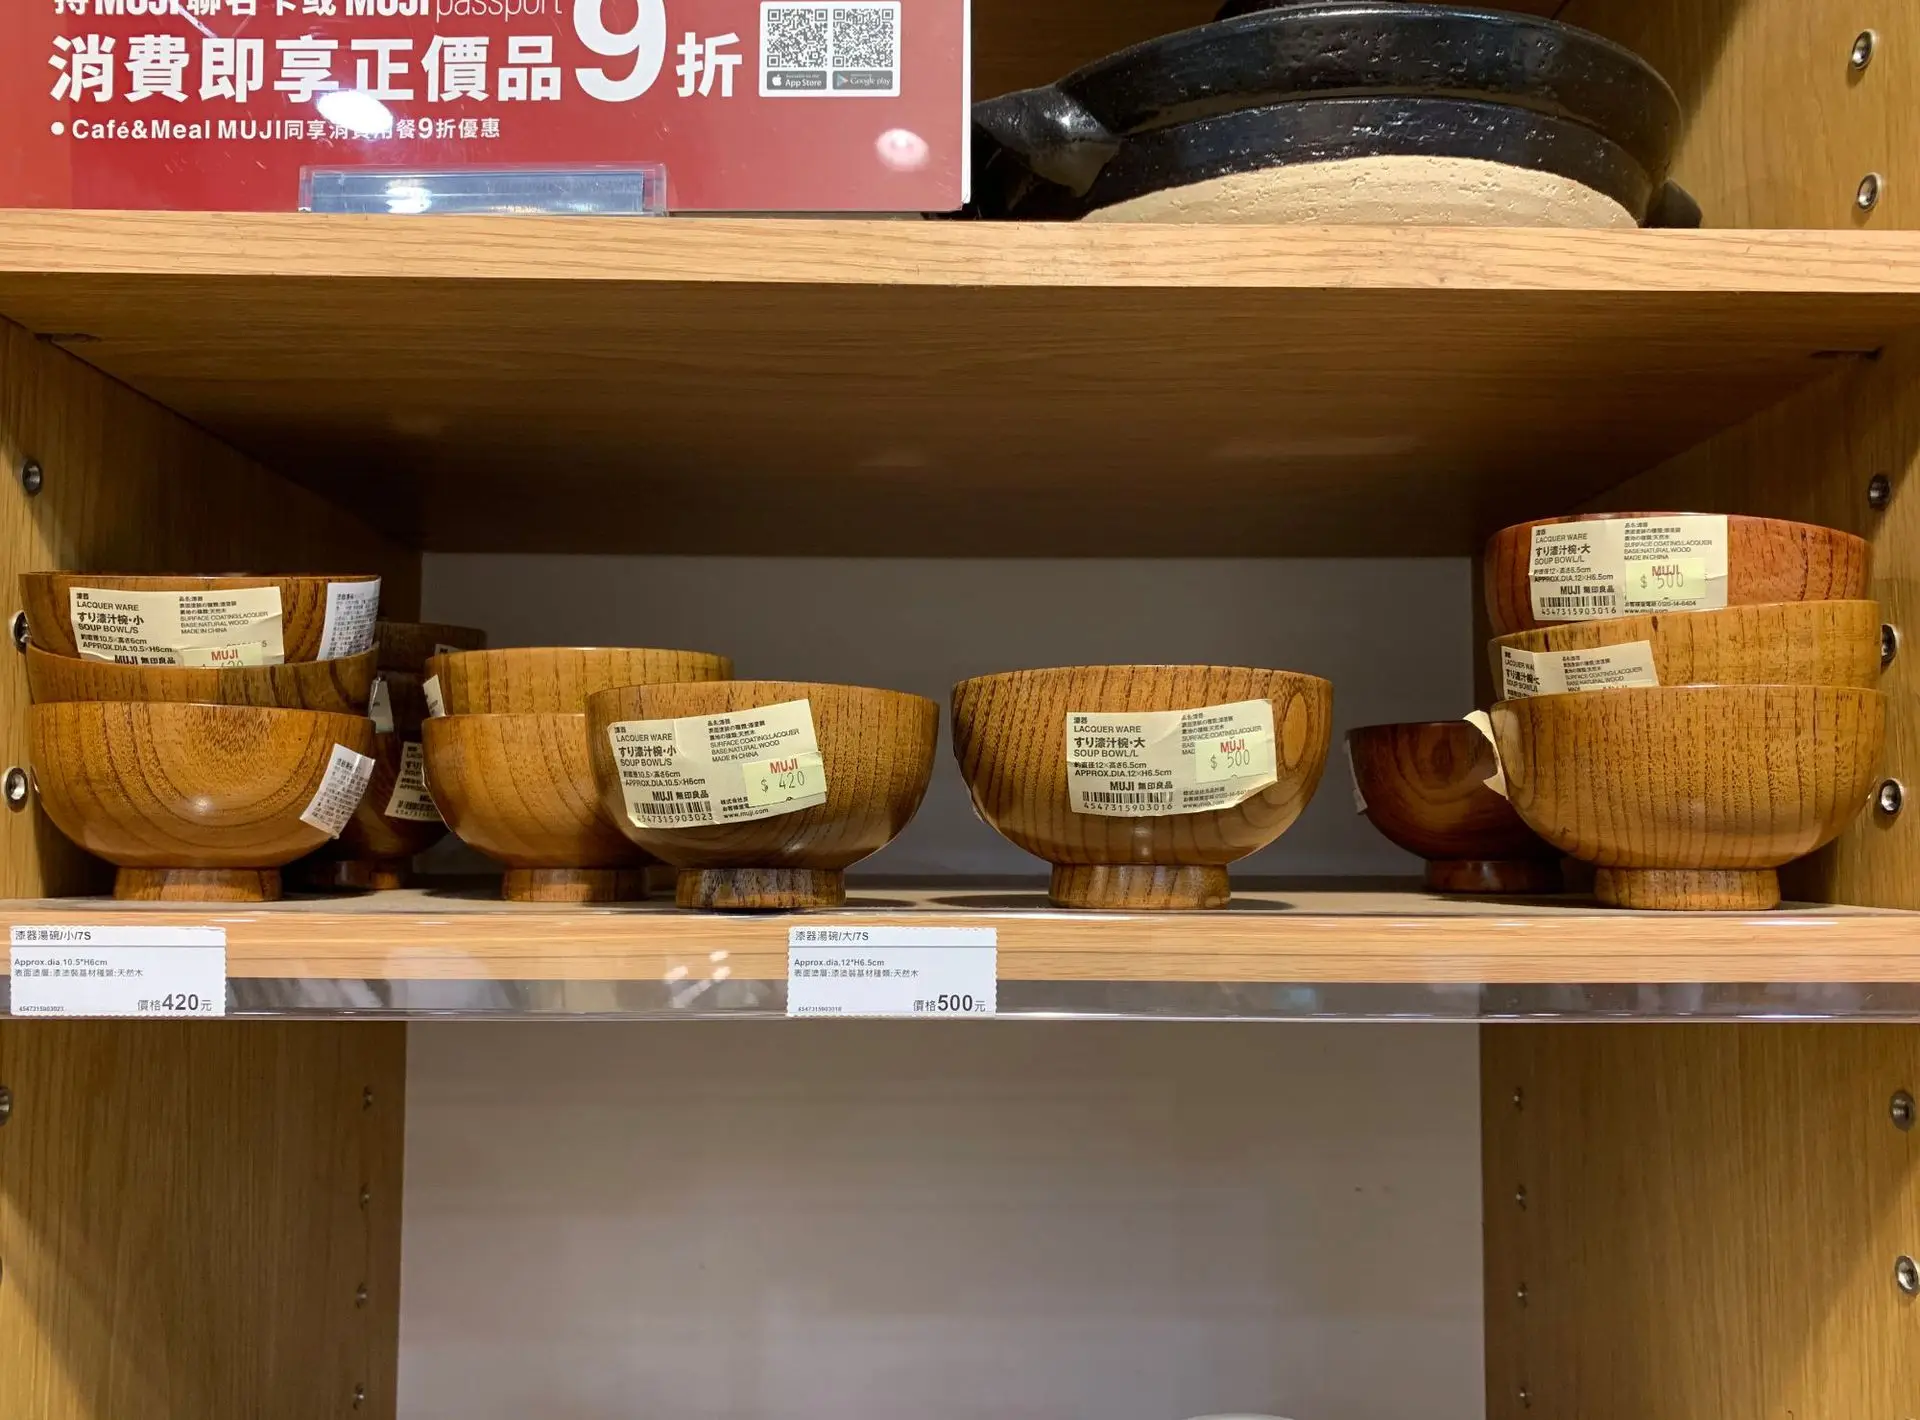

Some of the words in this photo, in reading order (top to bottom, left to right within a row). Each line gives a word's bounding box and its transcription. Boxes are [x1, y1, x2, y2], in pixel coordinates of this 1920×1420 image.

[72, 119, 210, 139] Café&Meal
[1567, 533, 1588, 541] WARE
[1534, 557, 1554, 566] SOUP
[1651, 564, 1680, 576] MUJI
[1560, 585, 1581, 595] MUJI
[77, 601, 113, 610] LACQUER
[114, 603, 139, 611] WARE
[78, 623, 102, 632] SOUP
[114, 654, 138, 665] MUJI
[211, 648, 239, 661] MUJI
[1073, 725, 1114, 733] LACQUER
[1115, 725, 1142, 733] WARE
[616, 734, 650, 742] LACQUER
[650, 733, 673, 741] WARE
[759, 739, 780, 749] WOOD
[1220, 738, 1245, 753] MUJI
[1073, 749, 1100, 757] SOUP
[620, 758, 640, 767] SOUP
[1227, 749, 1251, 769] 500
[769, 758, 799, 775] MUJI
[778, 770, 805, 790] 420
[1109, 781, 1135, 791] MUJI
[651, 790, 674, 801] MUJI
